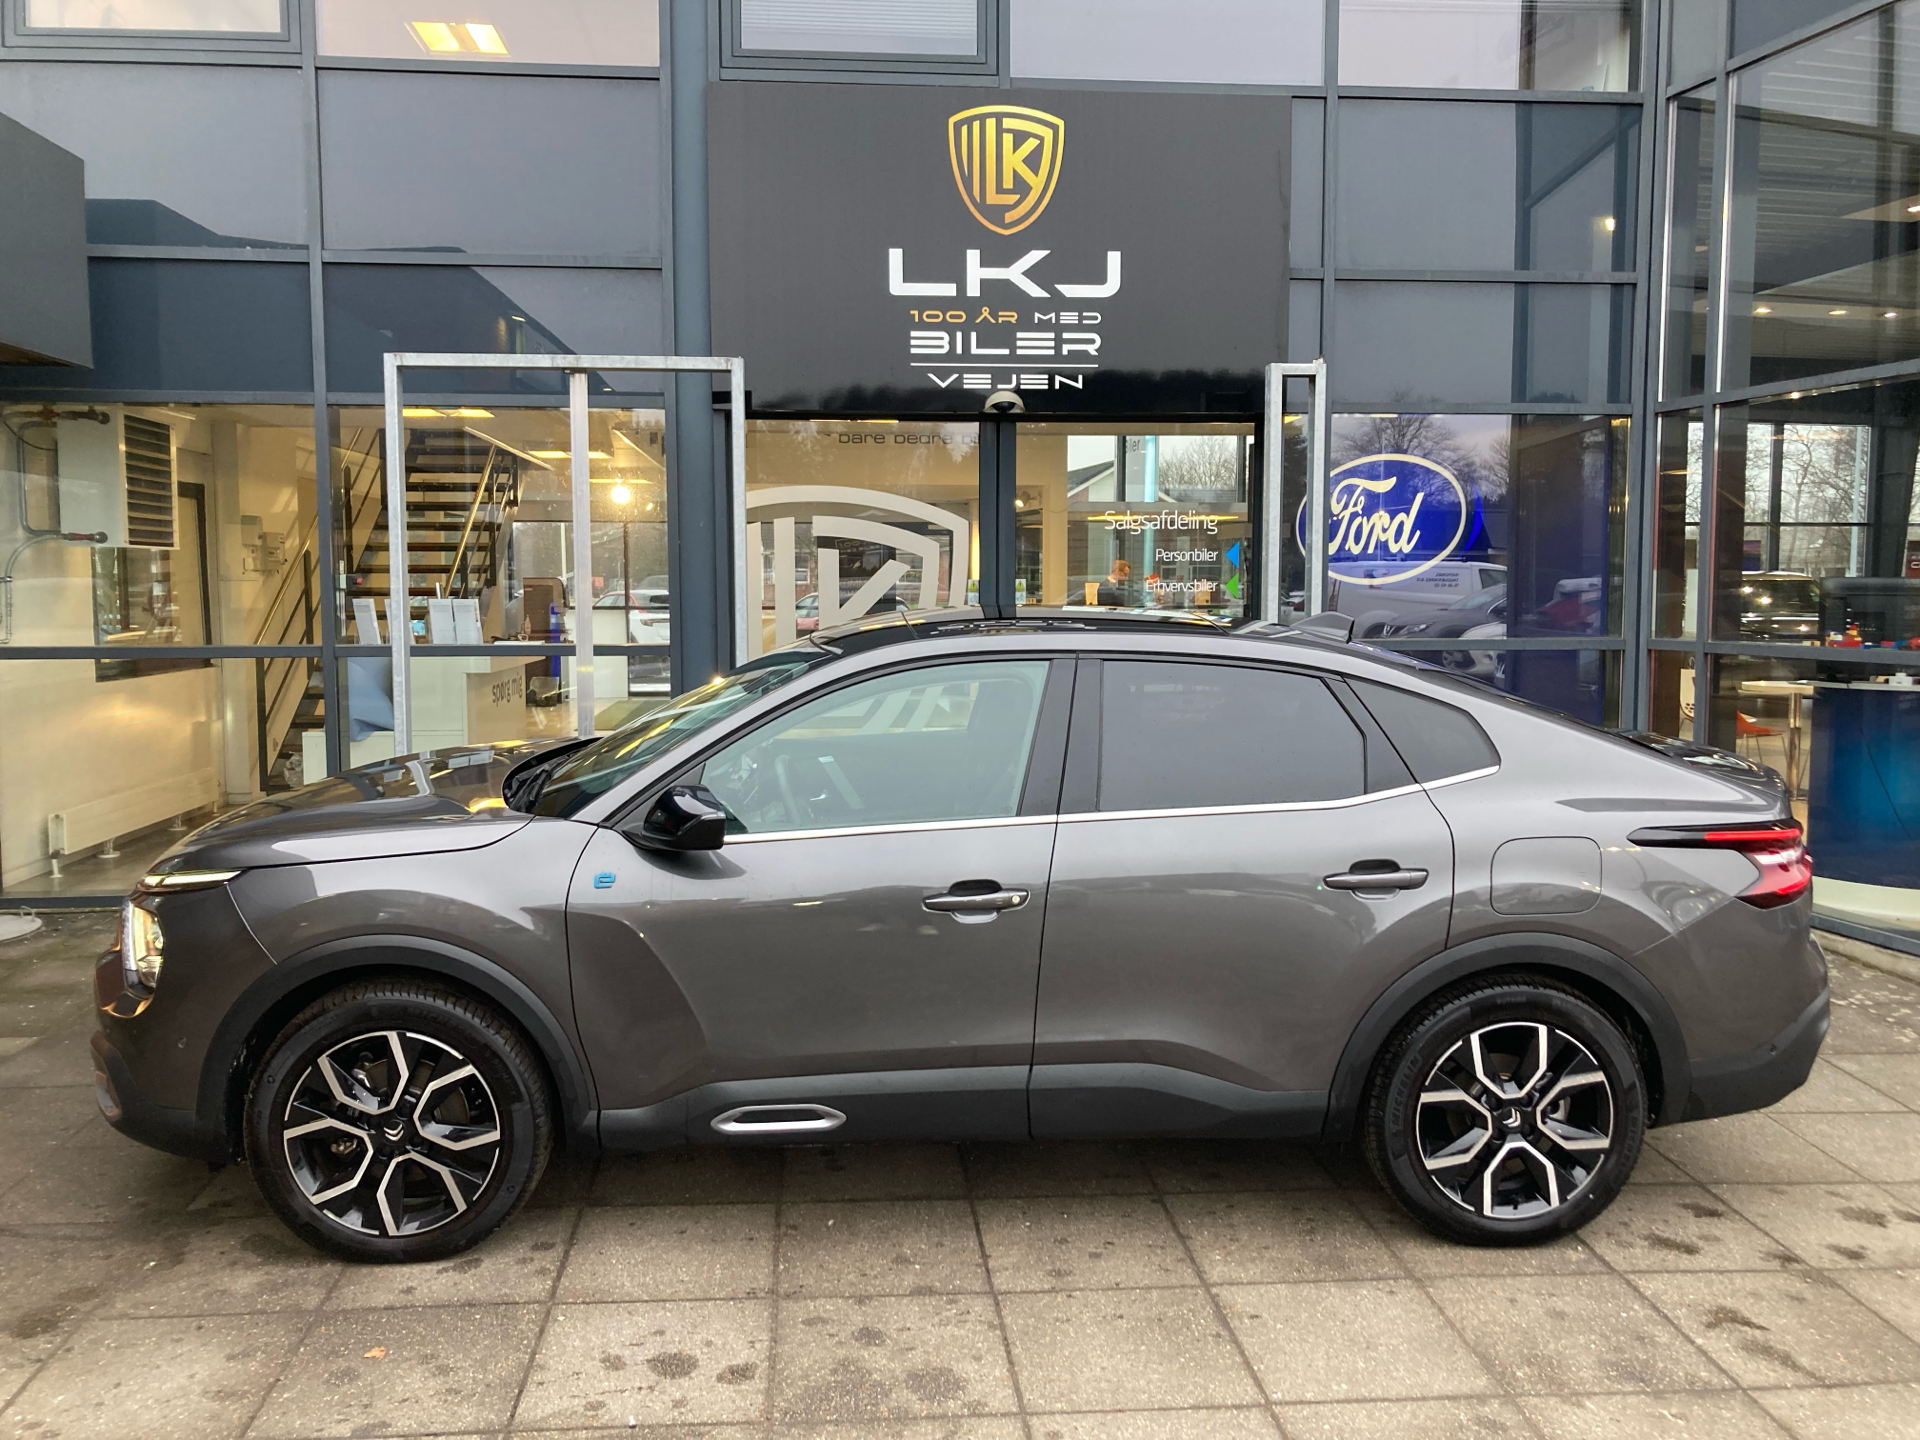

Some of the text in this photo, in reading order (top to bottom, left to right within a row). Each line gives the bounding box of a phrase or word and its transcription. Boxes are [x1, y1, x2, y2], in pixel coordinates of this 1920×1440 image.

[888, 248, 1122, 298] LKJ
[910, 306, 1102, 324] 100 ÅR MED
[910, 330, 1102, 355] BILER
[927, 373, 1083, 389] VEJEN
[1104, 510, 1218, 535] Salgsafdeling
[1328, 476, 1425, 555] Ford
[1155, 548, 1219, 562] Personbiler
[1146, 578, 1218, 592] Erhvervsbiler
